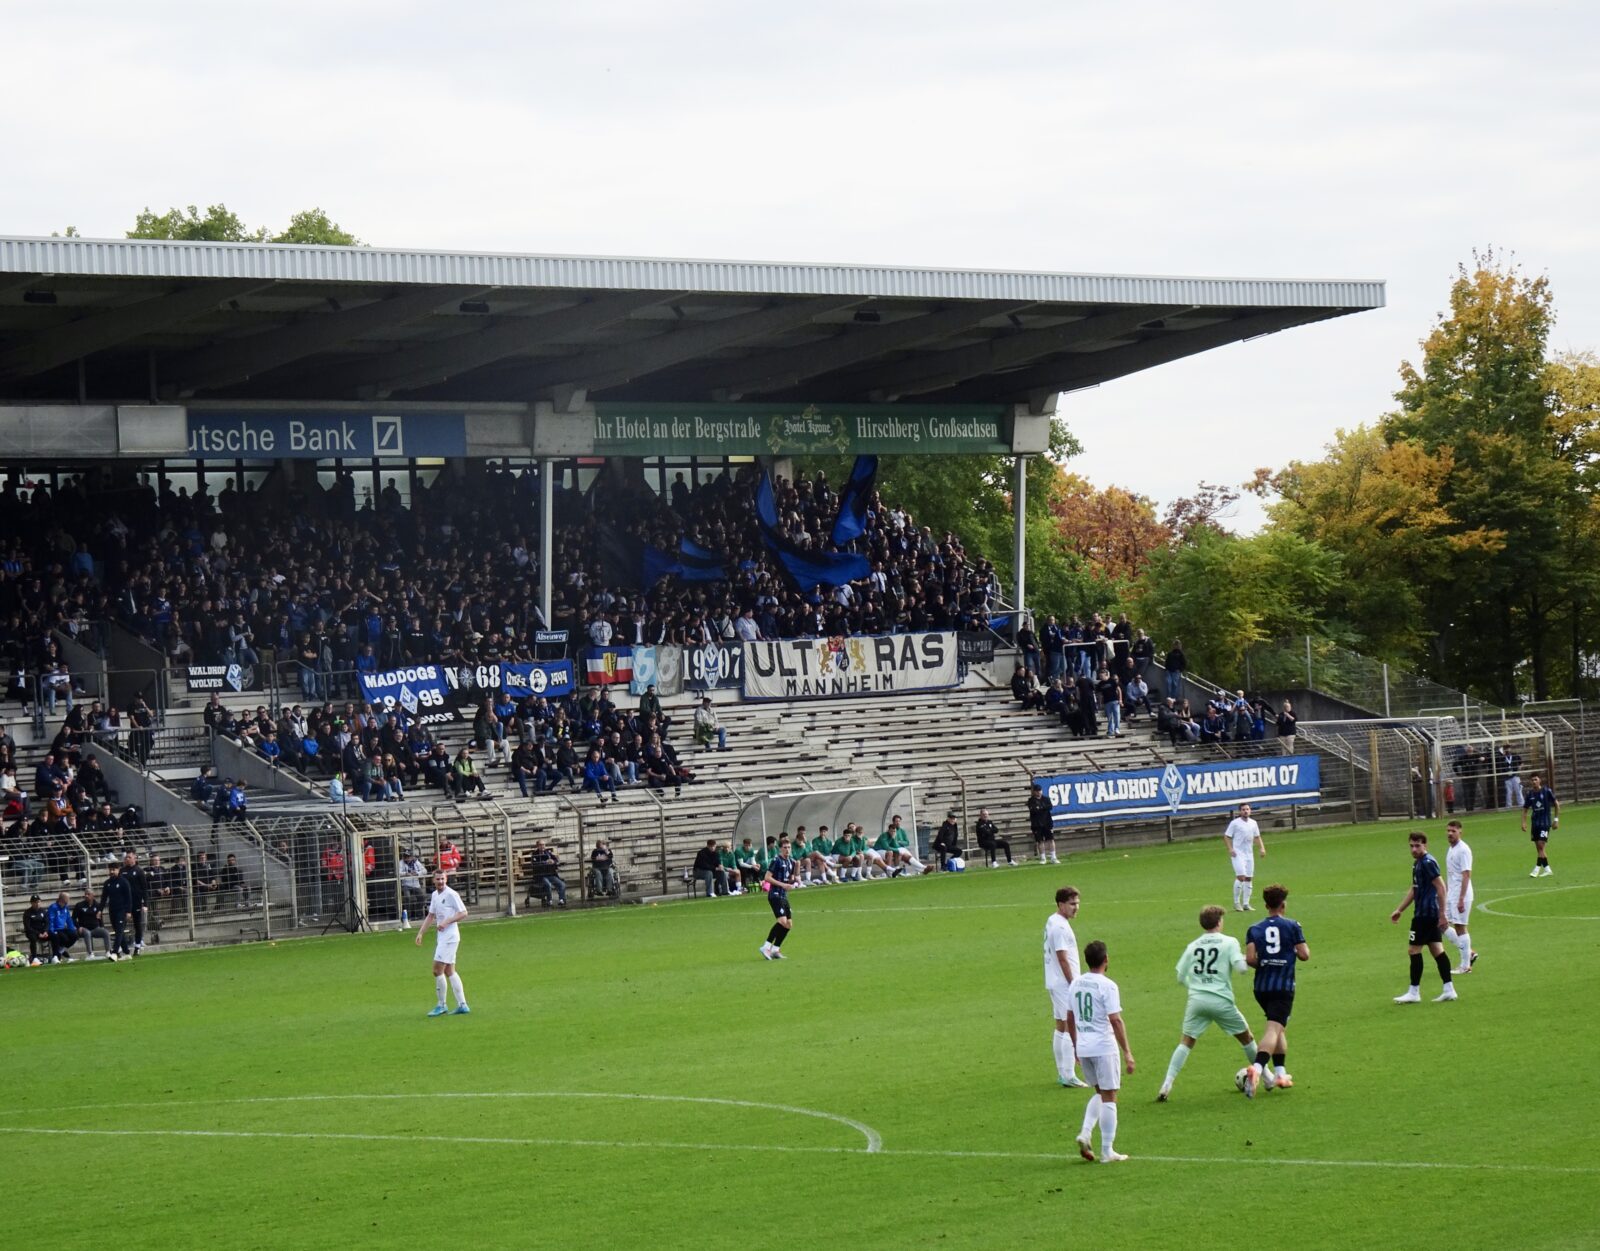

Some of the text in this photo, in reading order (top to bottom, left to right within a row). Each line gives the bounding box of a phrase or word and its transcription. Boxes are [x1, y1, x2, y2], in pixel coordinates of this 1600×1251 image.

[289, 421, 357, 451] Bank
[615, 416, 650, 439] Hotel
[653, 422, 668, 439] an
[671, 416, 691, 439] der
[694, 416, 761, 442] Bergstraße
[856, 416, 920, 441] Hirschberg
[929, 416, 998, 439] Großsachsen
[187, 666, 227, 676] WALDHOF
[189, 678, 224, 688] WOLVES
[363, 665, 437, 688] MADDOGS
[475, 664, 501, 688] 68
[786, 673, 894, 696] MANNHEIM
[418, 688, 444, 707] 95
[1047, 764, 1299, 807] SV WALDHOF MANNHEIM 07
[1264, 925, 1281, 954] 9
[1193, 947, 1219, 975] 32
[1074, 991, 1093, 1023] 18
